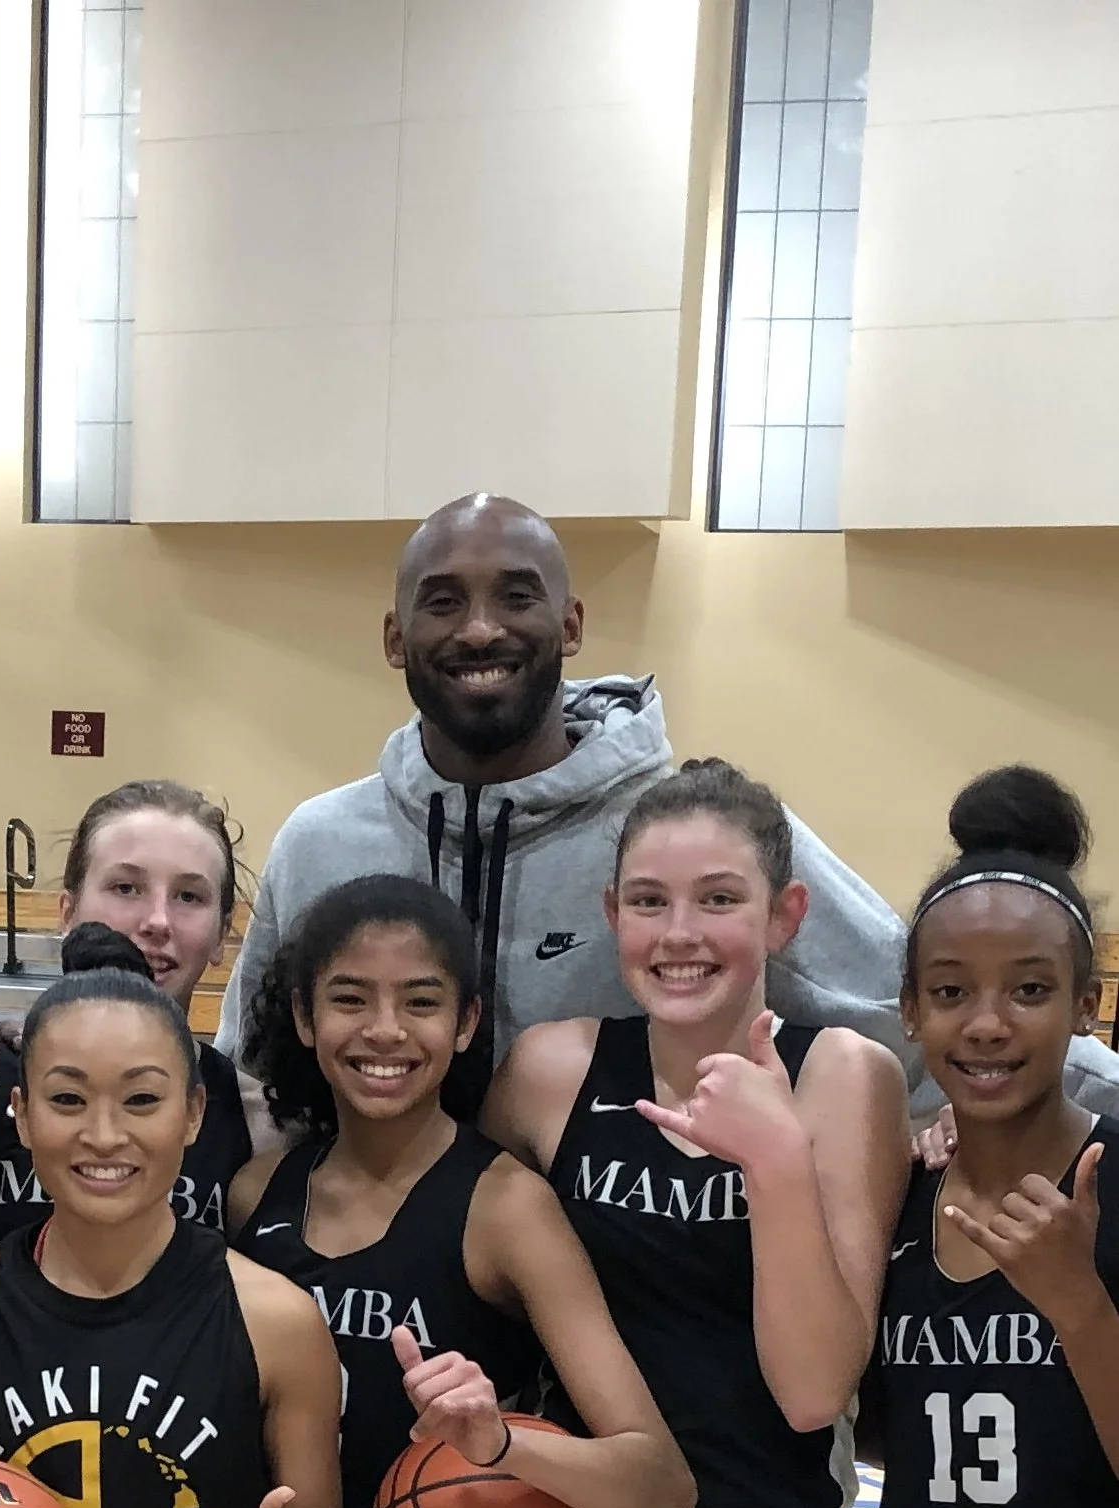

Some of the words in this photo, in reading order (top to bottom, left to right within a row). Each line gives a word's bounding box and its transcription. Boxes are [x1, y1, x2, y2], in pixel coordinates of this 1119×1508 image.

[71, 713, 86, 723] NO
[64, 723, 92, 734] FOOD
[70, 734, 85, 744] OR
[63, 744, 92, 755] DRINK
[543, 932, 577, 948] NIKE
[572, 1155, 751, 1223] MAMB
[311, 1285, 437, 1349] MBA
[924, 1392, 1018, 1505] 13
